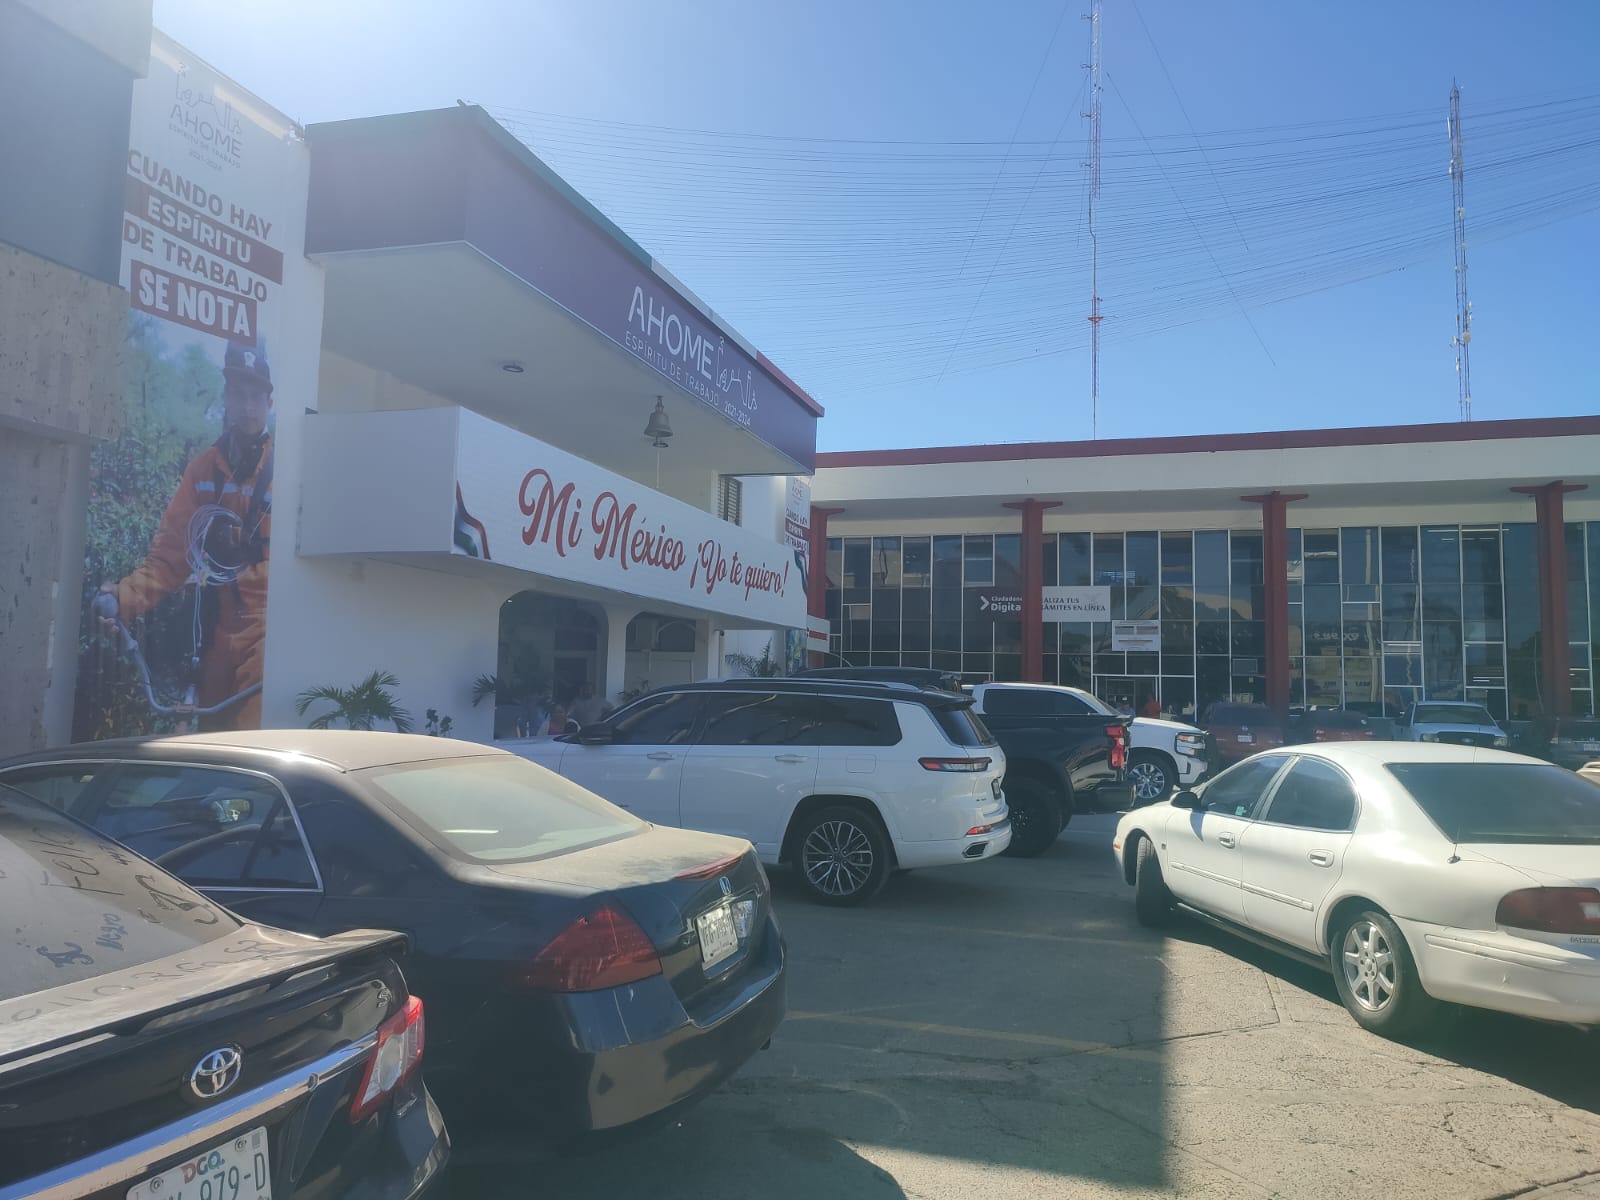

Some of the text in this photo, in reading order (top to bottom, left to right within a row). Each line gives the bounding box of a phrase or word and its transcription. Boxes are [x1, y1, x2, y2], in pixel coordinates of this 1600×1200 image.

[169, 104, 242, 159] AHOME
[128, 148, 272, 241] CUANDO HAY
[149, 194, 251, 264] ESPÍRITU
[123, 218, 268, 302] DE TRABAJO
[138, 267, 251, 337] SE NOTA
[628, 286, 714, 381] AHOME
[625, 330, 751, 426] ESPÍRITU DE TRABAJO 2021-2024
[518, 468, 790, 601] Mi México ¡Yo te quiero!
